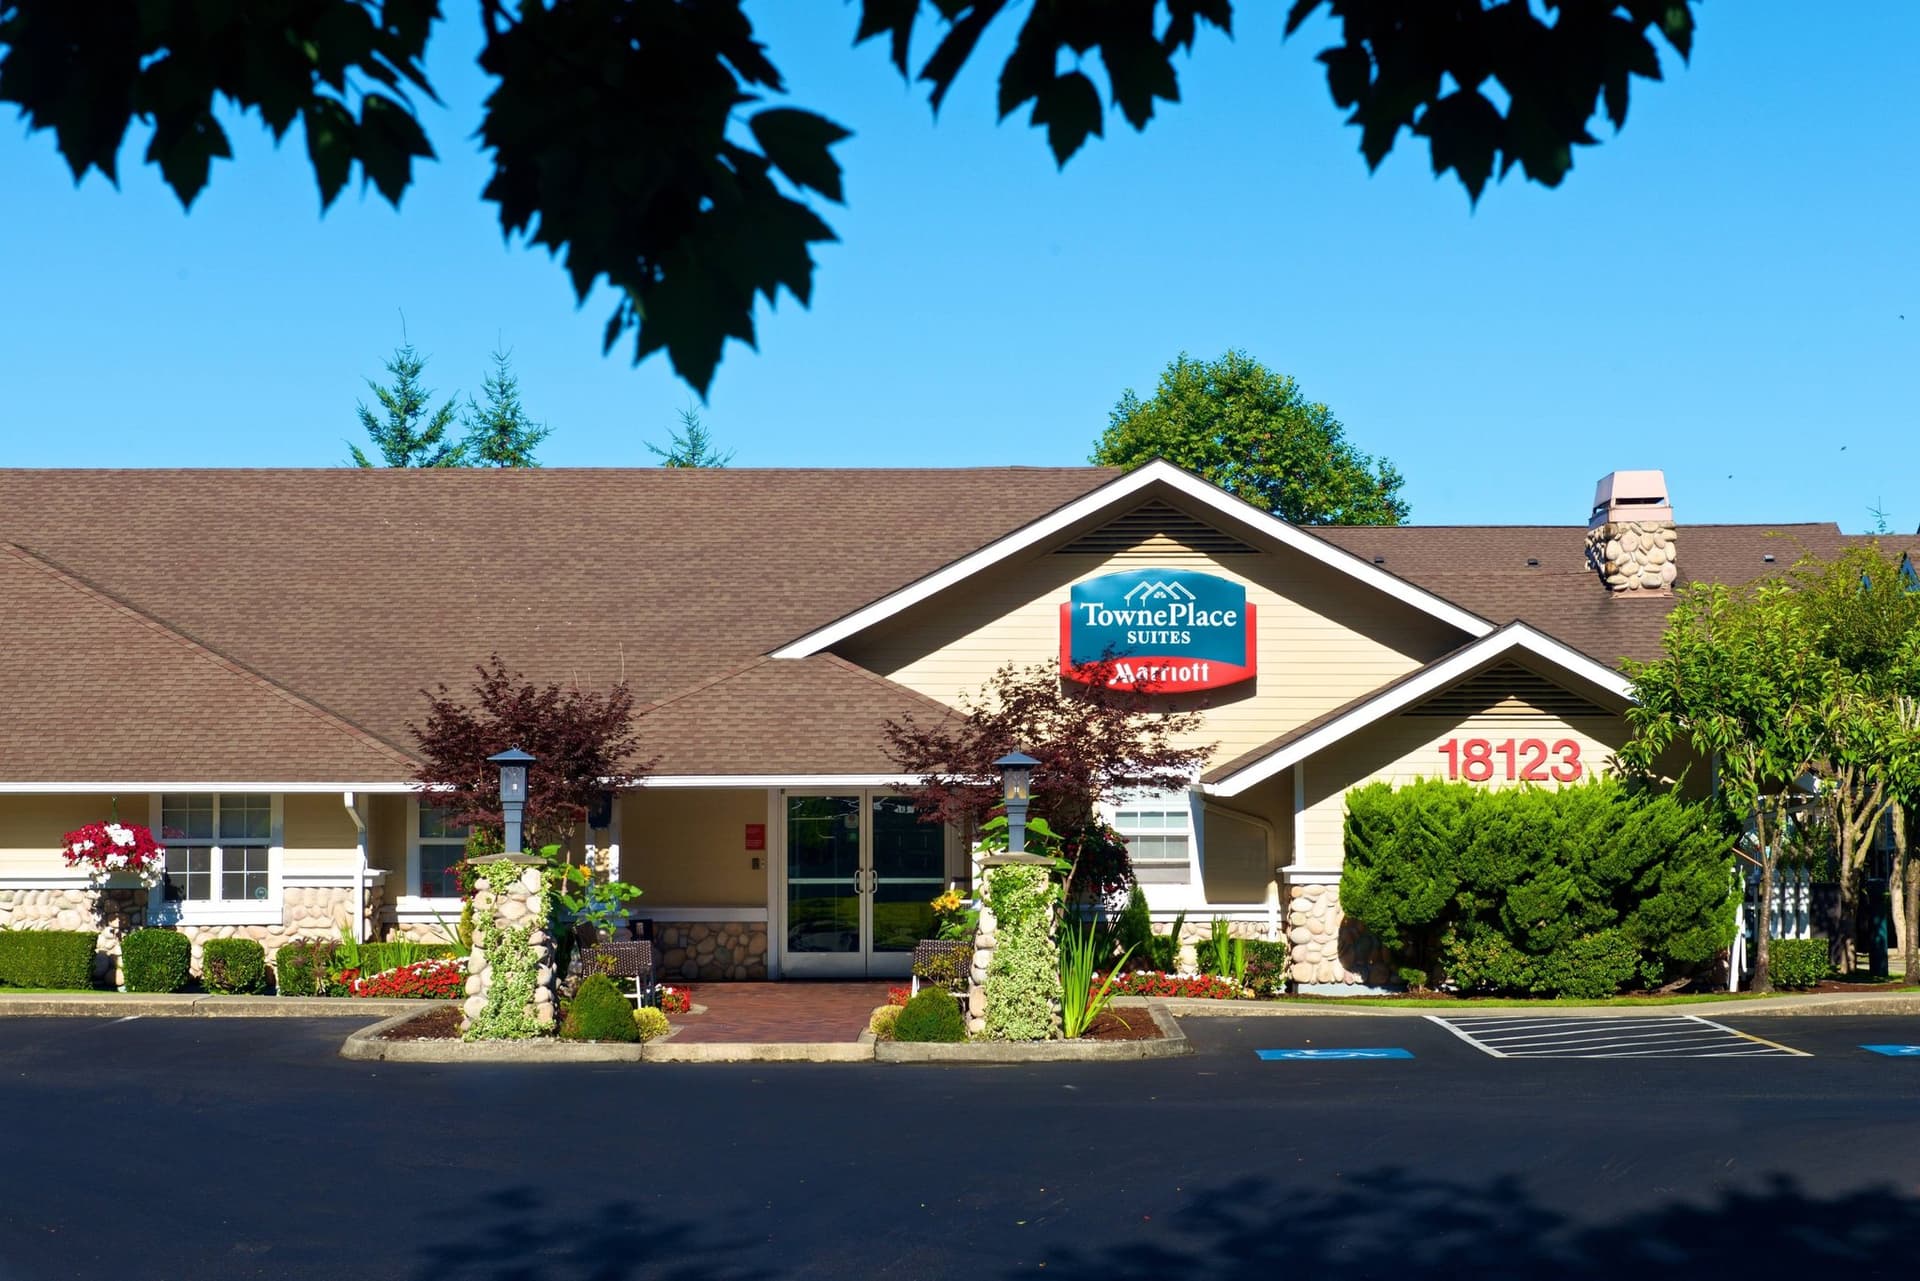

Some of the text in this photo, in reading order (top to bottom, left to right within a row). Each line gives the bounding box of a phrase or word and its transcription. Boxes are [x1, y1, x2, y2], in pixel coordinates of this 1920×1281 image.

[1080, 602, 1237, 627] TownePlace
[1127, 630, 1191, 645] SUITES
[1108, 662, 1209, 685] Marriott
[1438, 738, 1583, 782] 18123
